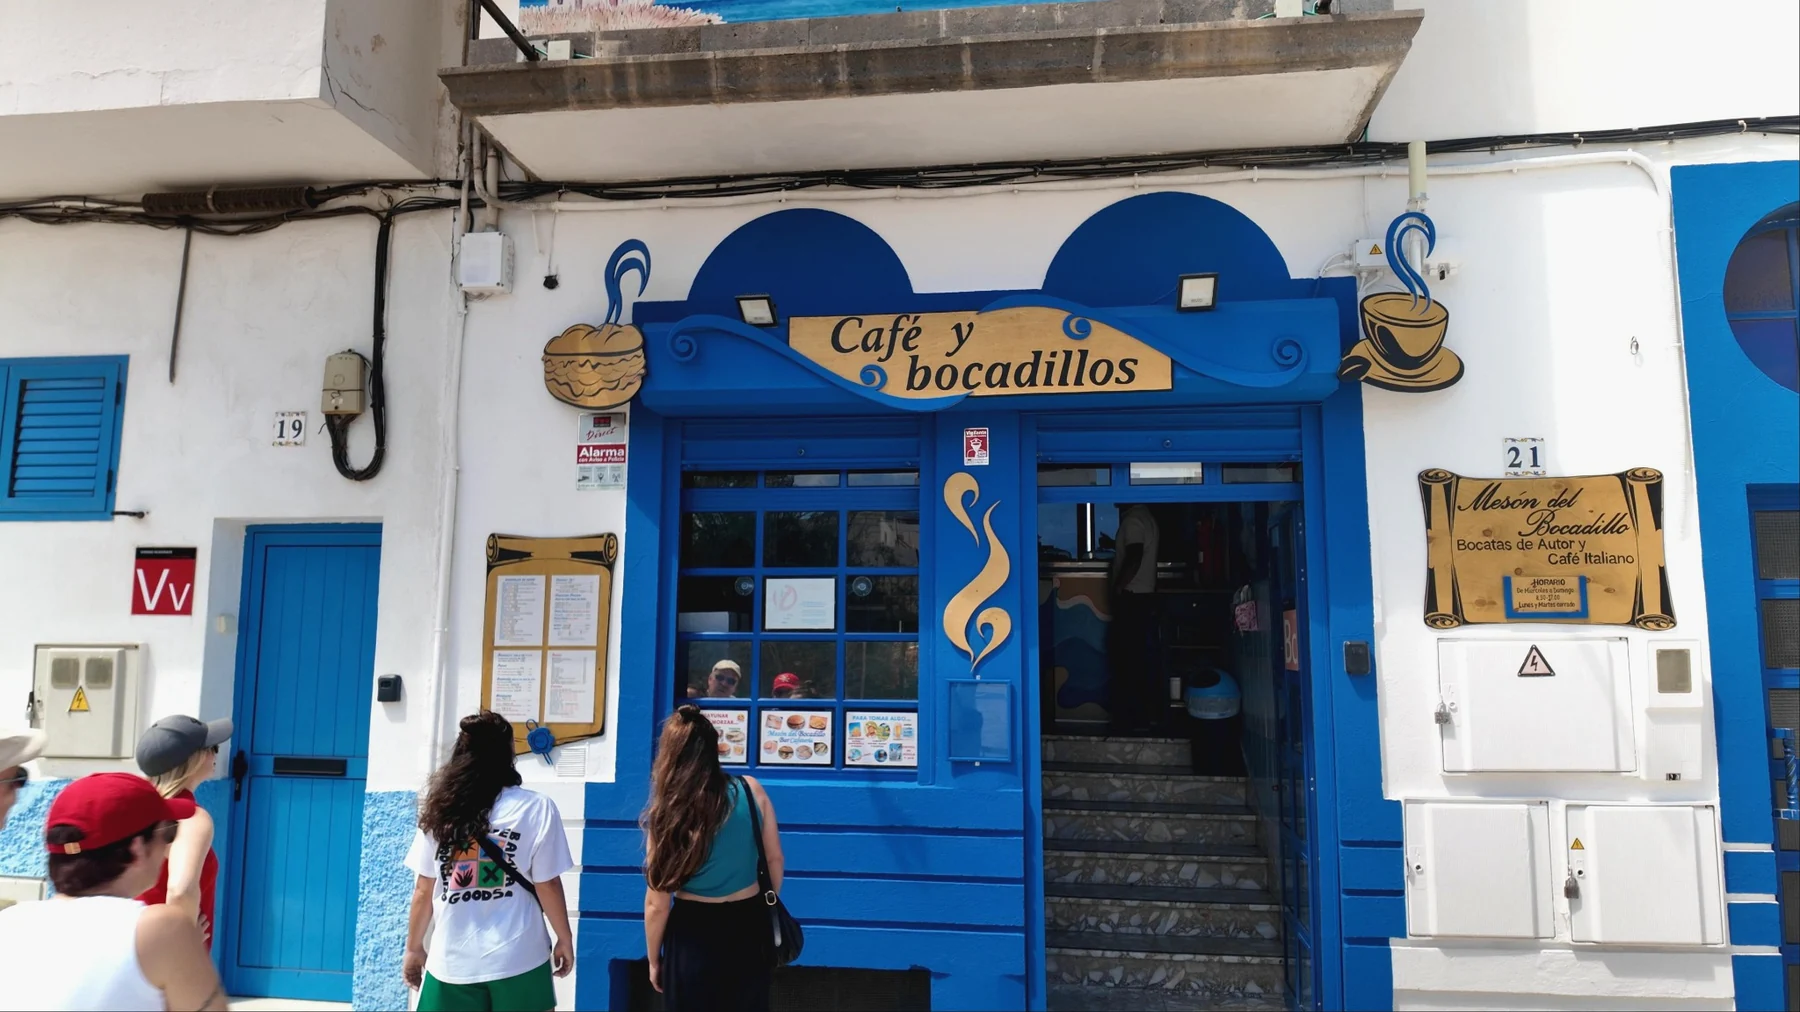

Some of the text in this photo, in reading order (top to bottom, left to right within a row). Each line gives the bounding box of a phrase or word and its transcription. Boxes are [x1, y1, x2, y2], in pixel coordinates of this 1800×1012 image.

[831, 314, 974, 362] Café y
[906, 349, 1138, 391] bocadillos
[277, 419, 303, 439] 19
[579, 446, 625, 458] Alarma
[1507, 446, 1541, 468] 21
[1457, 482, 1584, 511] Mesón del
[1518, 509, 1630, 537] Bocadillo
[1457, 539, 1586, 552] Bocatas de Autor y
[1548, 551, 1635, 565] Café Italiano
[1533, 578, 1566, 586] HORARIO
